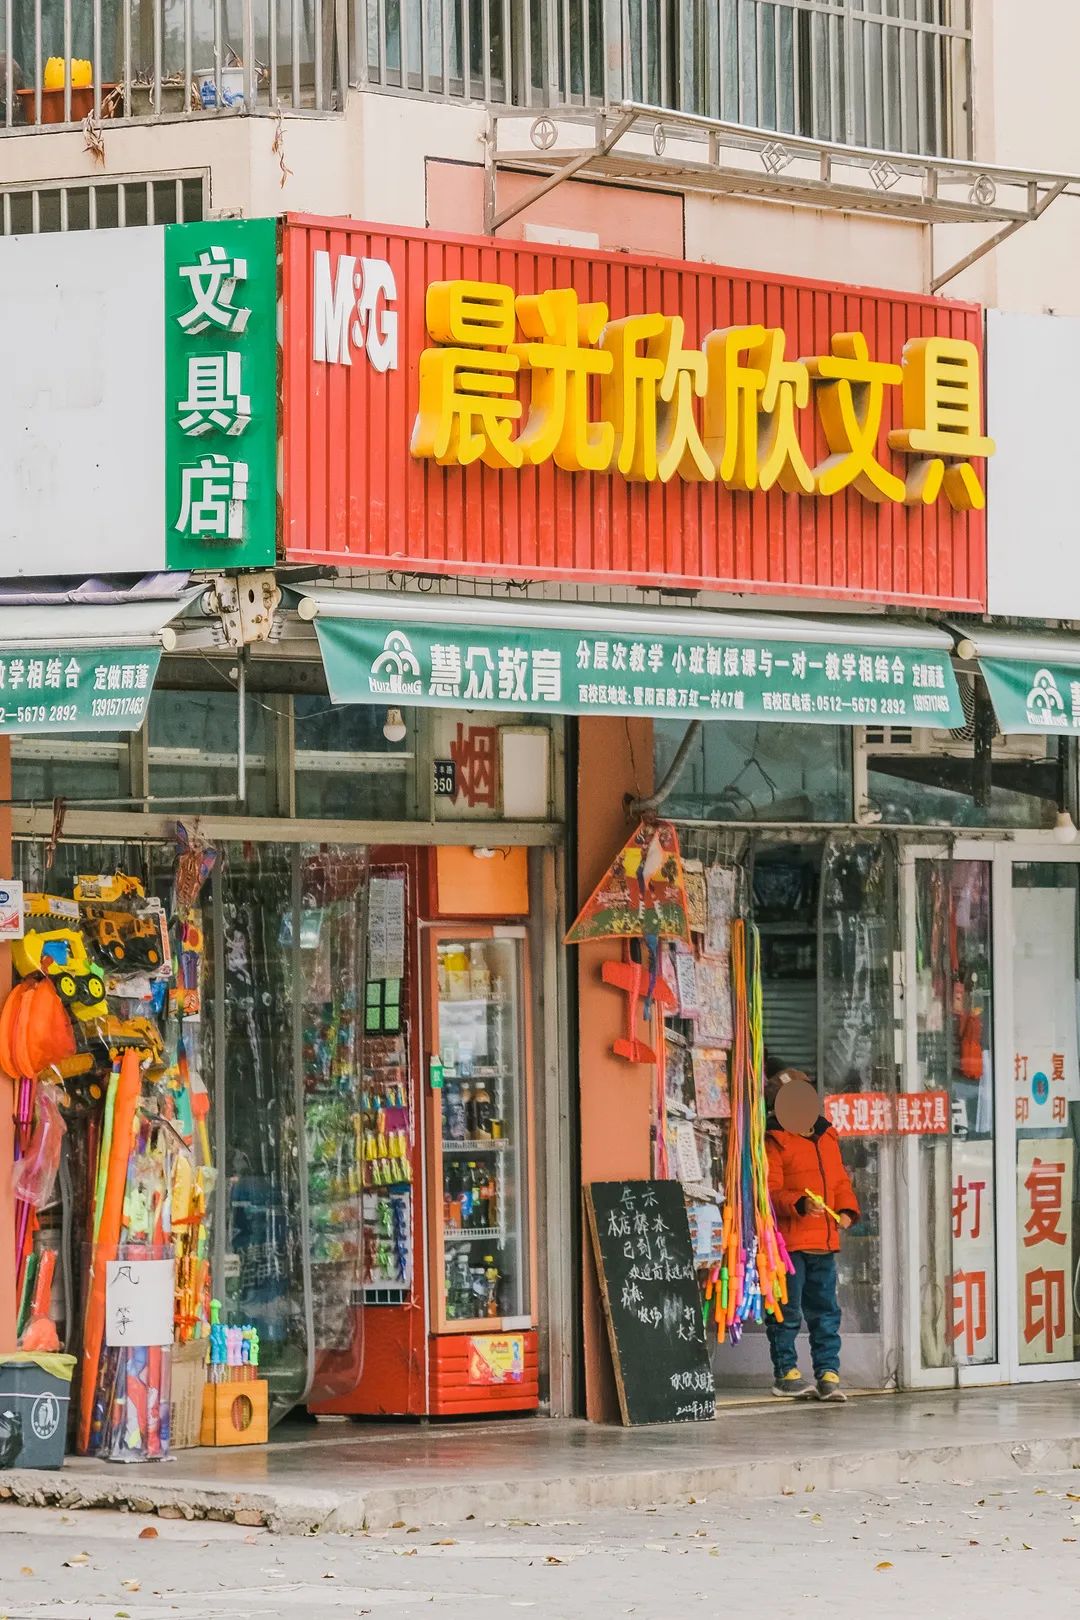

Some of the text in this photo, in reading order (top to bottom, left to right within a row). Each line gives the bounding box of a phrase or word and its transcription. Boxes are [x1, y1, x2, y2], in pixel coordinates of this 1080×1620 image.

[313, 250, 398, 373] M&G
[176, 246, 251, 540] 文具店
[411, 280, 996, 510] 晨光欣欣文具
[428, 644, 562, 702] 慧众教育
[576, 639, 905, 685] 分层次教学 小班制授课与一对一教学相结合
[48, 704, 78, 721] 2892
[91, 696, 145, 717] 13915717463
[880, 698, 906, 715] 2892
[449, 722, 497, 809] 烟
[620, 1185, 659, 1210] 告示
[946, 1174, 987, 1357] 打印
[1023, 1157, 1068, 1354] 复印
